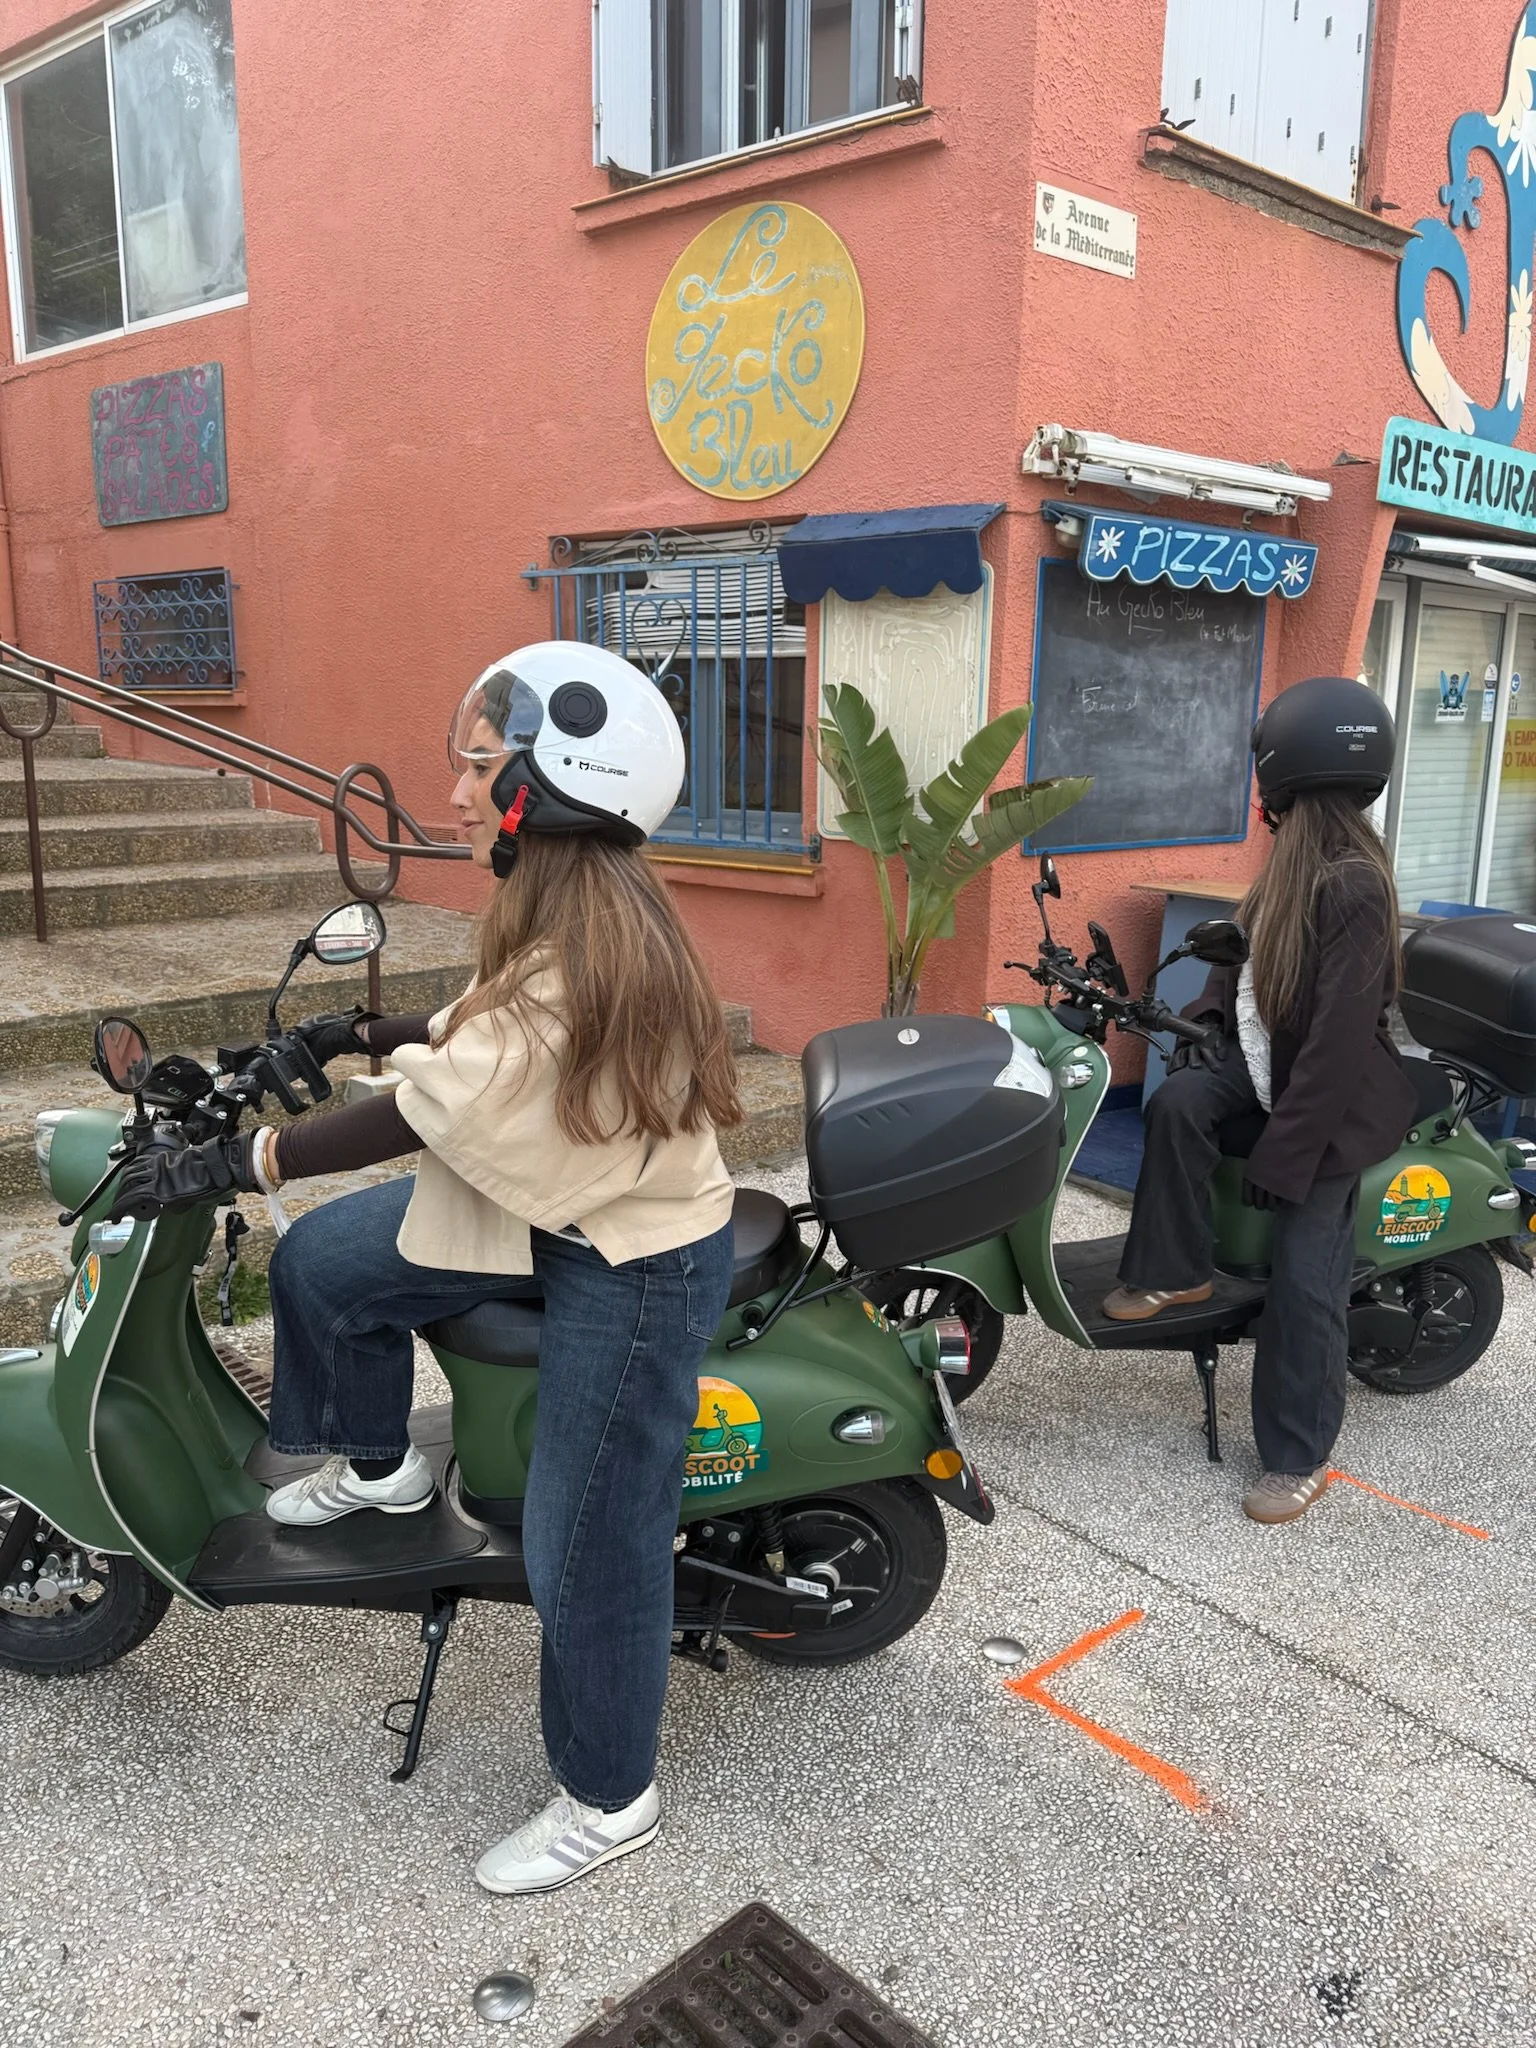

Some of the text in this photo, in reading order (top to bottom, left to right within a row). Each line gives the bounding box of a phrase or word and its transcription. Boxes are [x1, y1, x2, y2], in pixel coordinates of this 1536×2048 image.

[1065, 199, 1110, 233] Avenue
[678, 204, 797, 313] Le
[1035, 219, 1135, 268] de la Méditerranée
[96, 368, 208, 432] PIZZAS
[681, 398, 802, 490] Bleu
[102, 461, 215, 520] SALADES
[1388, 434, 1536, 518] RESTAURA
[1335, 725, 1378, 734] COURSE
[590, 764, 629, 777] COURSE
[1375, 1219, 1445, 1236] LEUSCOOT
[1383, 1231, 1432, 1244] MOBILITÉ
